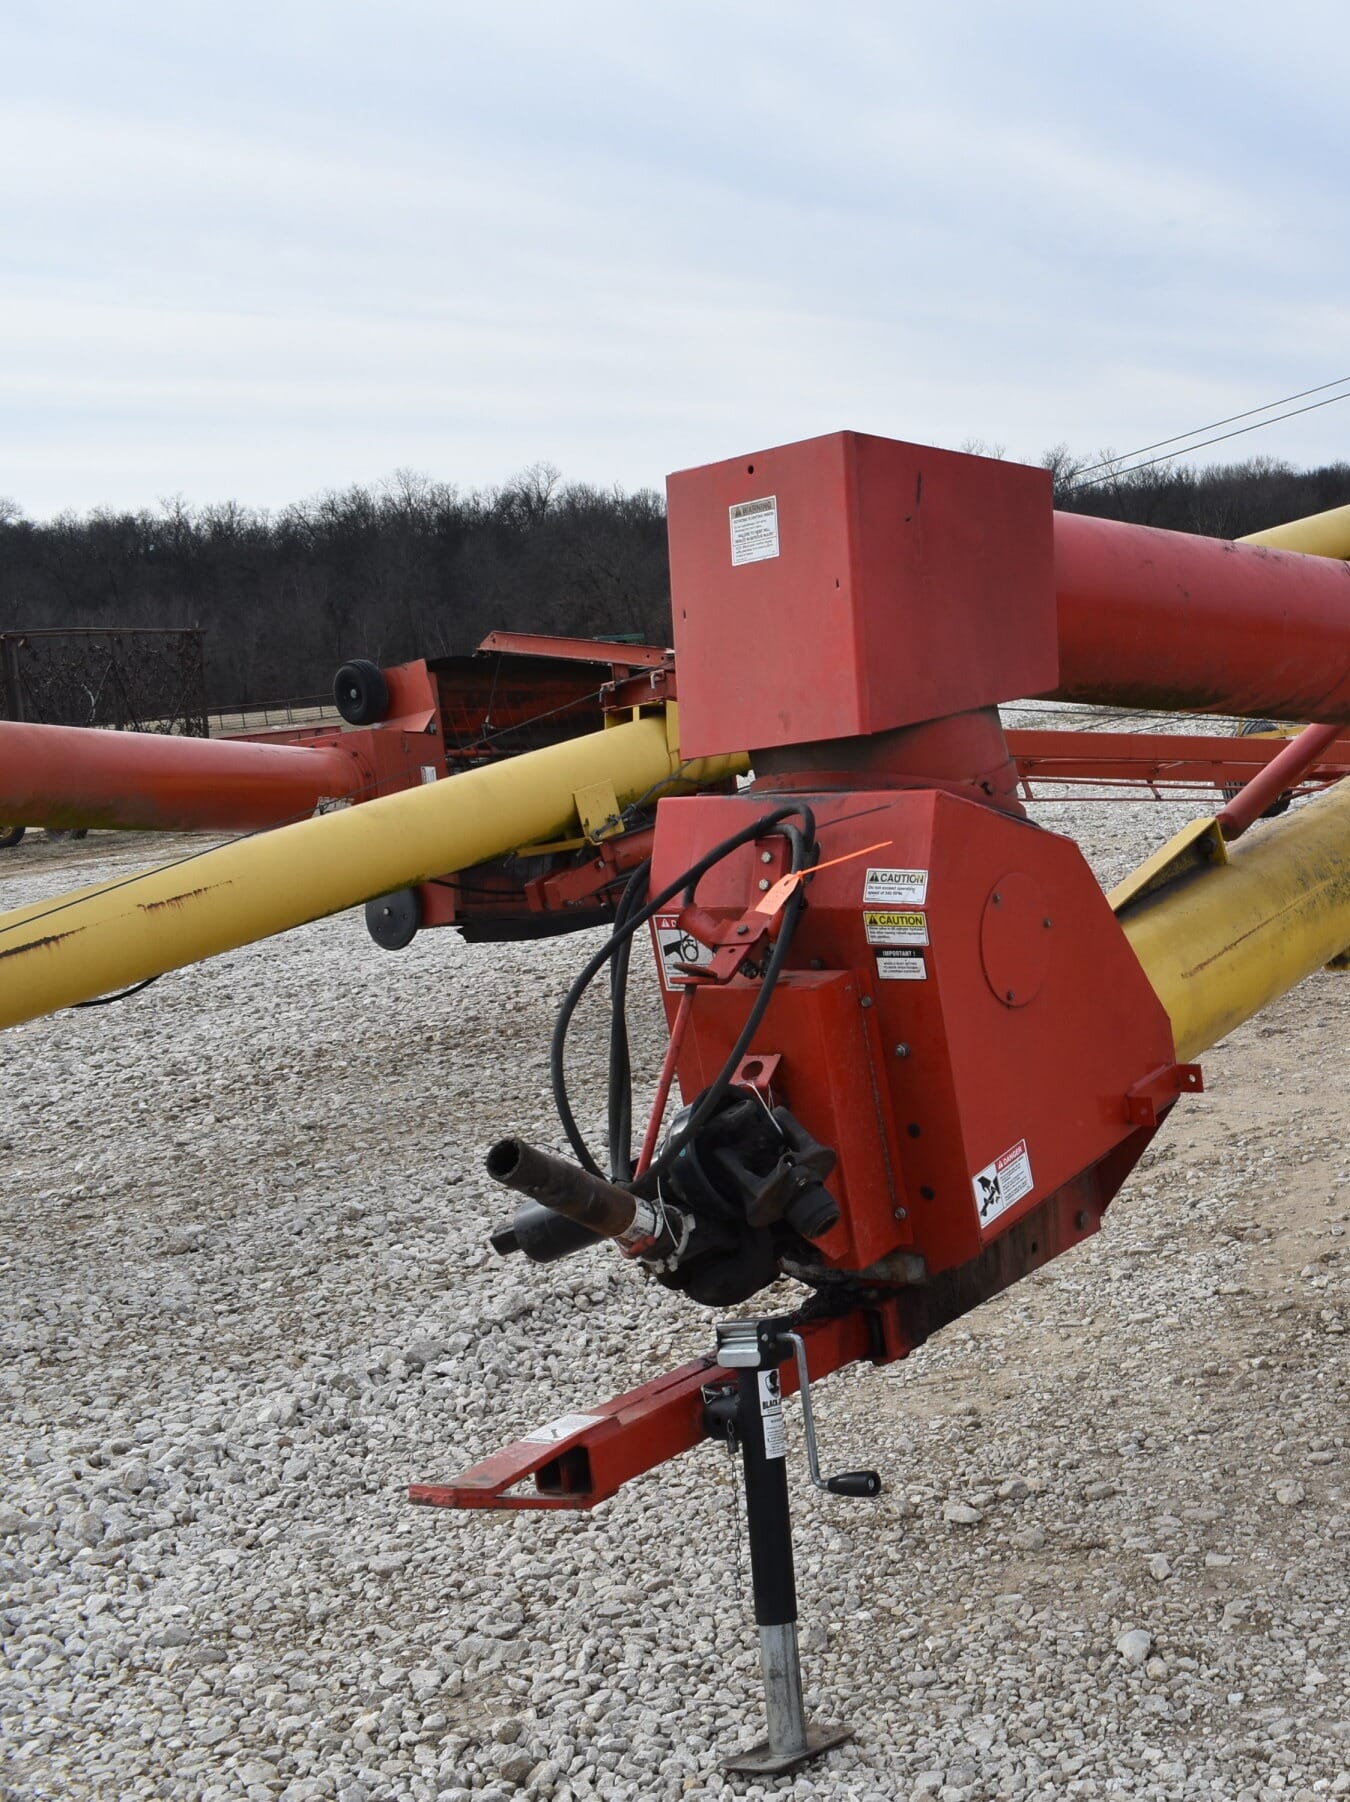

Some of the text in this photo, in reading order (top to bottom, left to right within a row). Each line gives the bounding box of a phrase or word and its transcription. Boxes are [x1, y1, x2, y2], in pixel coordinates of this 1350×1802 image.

[742, 501, 772, 516] WARNING
[880, 873, 924, 884] CAUTION
[879, 915, 923, 926] CAUTION
[1003, 1145, 1023, 1166] DANGER
